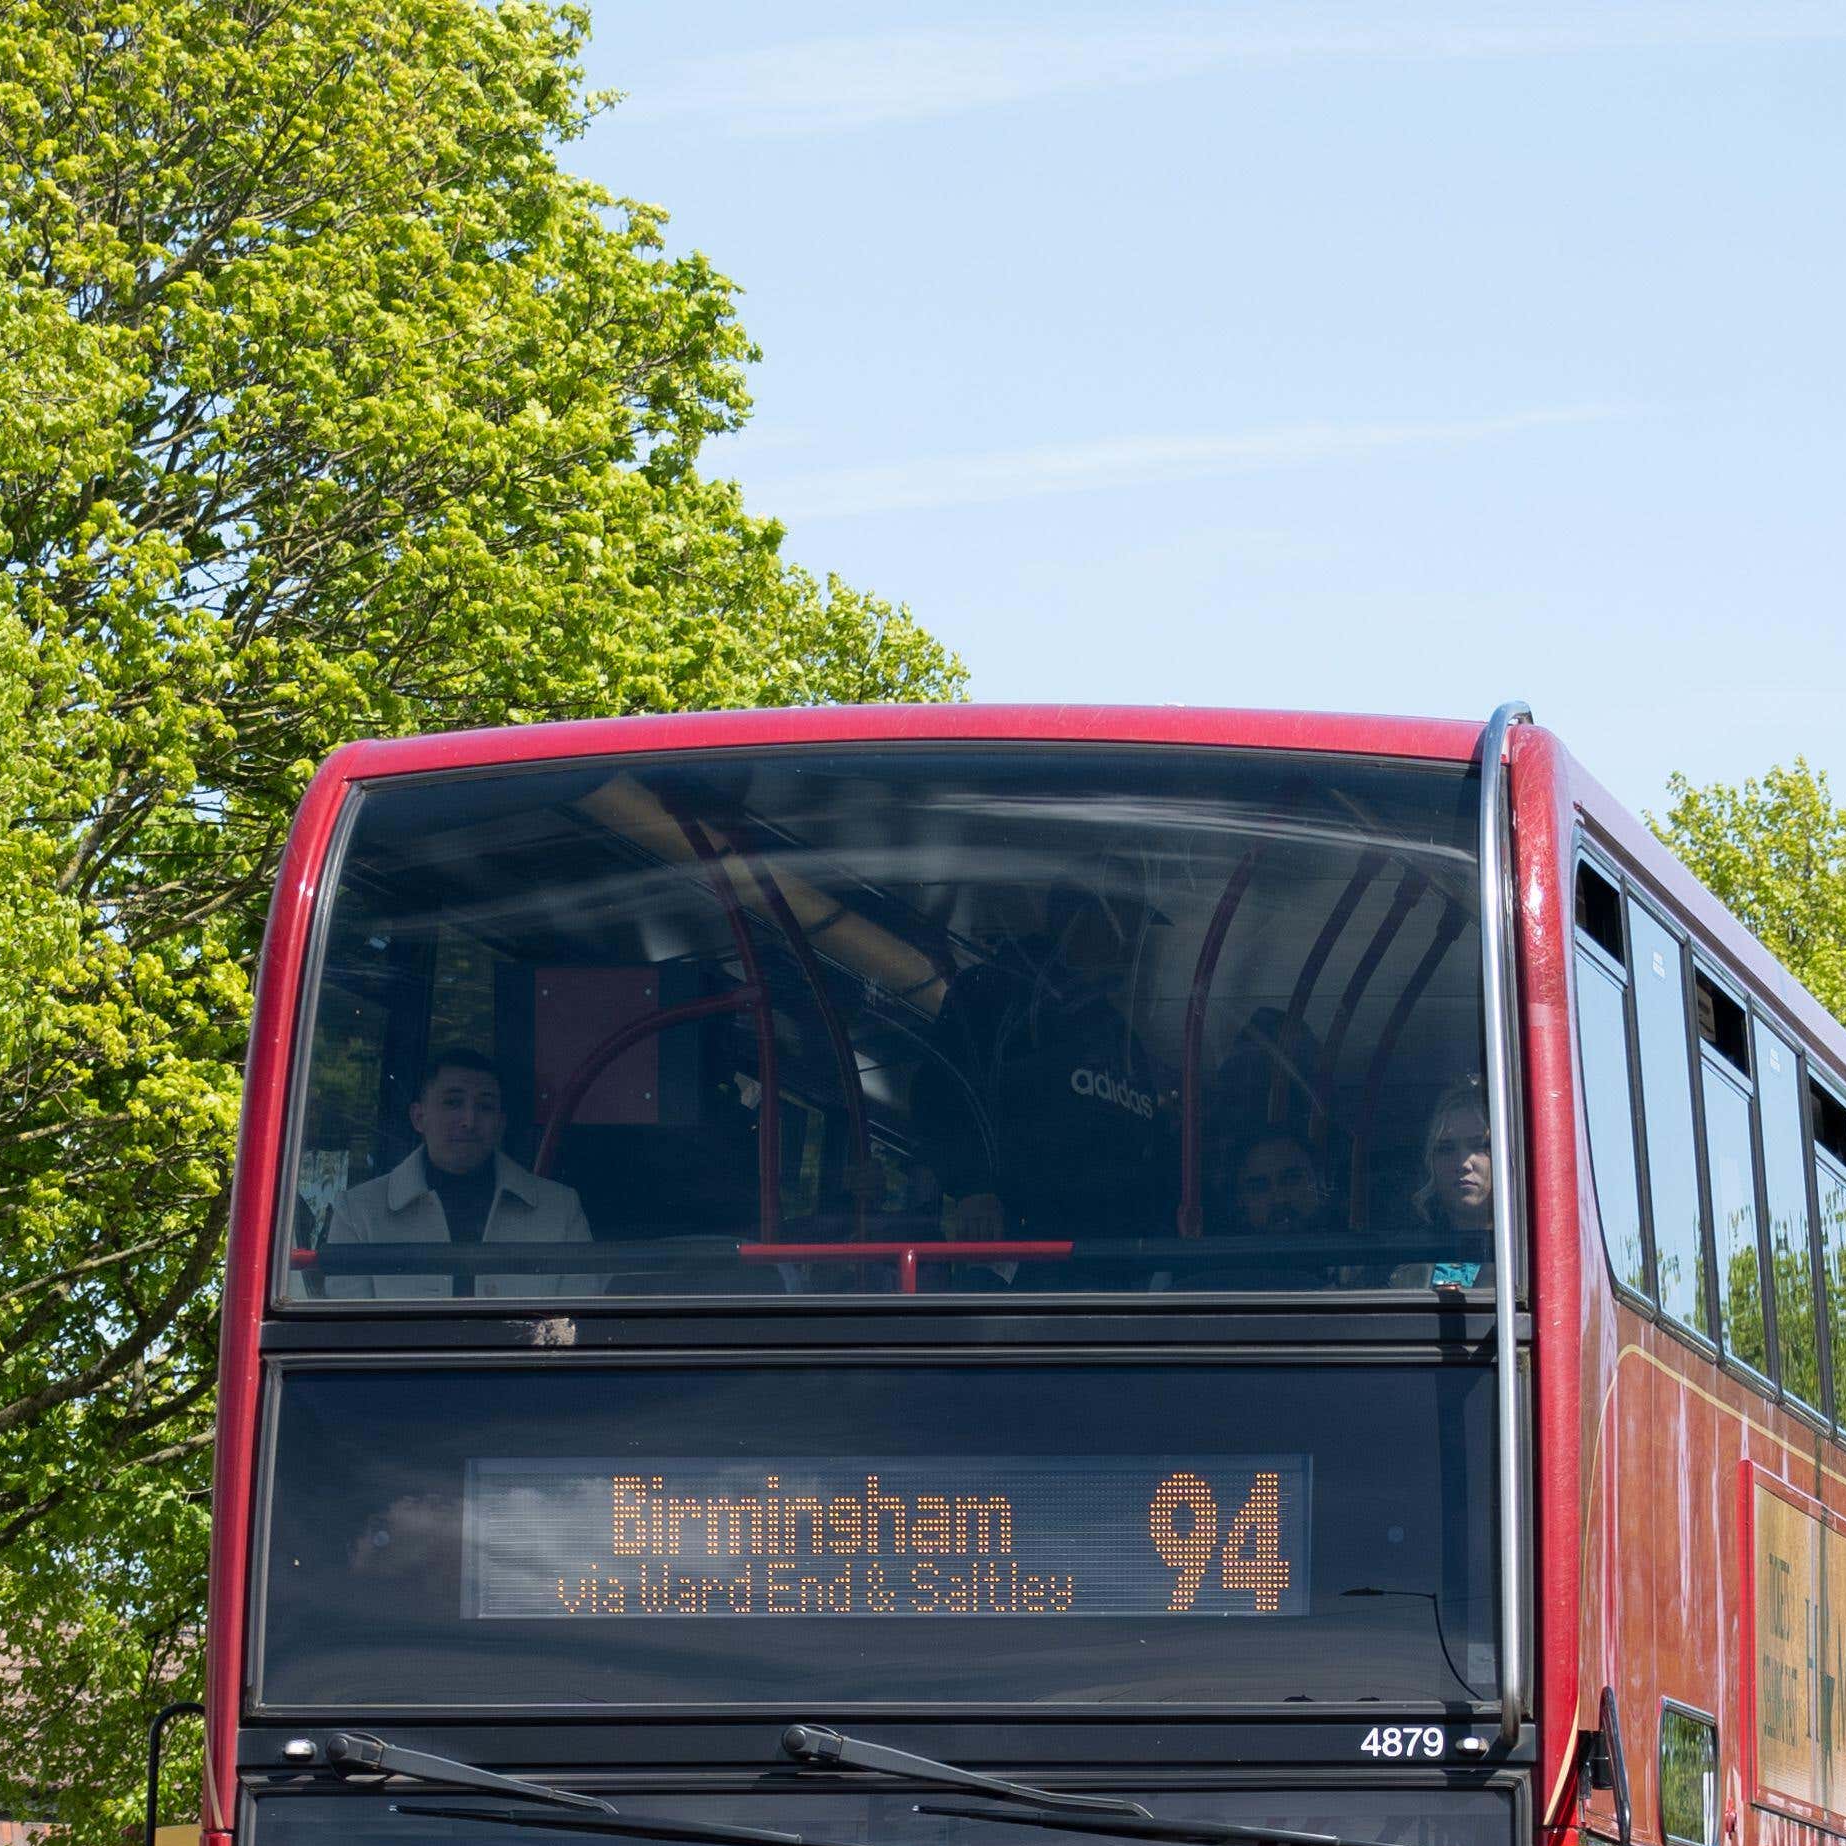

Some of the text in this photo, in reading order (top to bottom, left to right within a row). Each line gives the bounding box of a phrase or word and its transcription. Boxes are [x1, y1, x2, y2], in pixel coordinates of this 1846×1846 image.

[1071, 1068, 1153, 1120] adidas
[611, 1473, 1290, 1612] Birmingham 94
[557, 1563, 1074, 1613] via Ward End & Saltley
[1360, 1727, 1444, 1757] 4879
